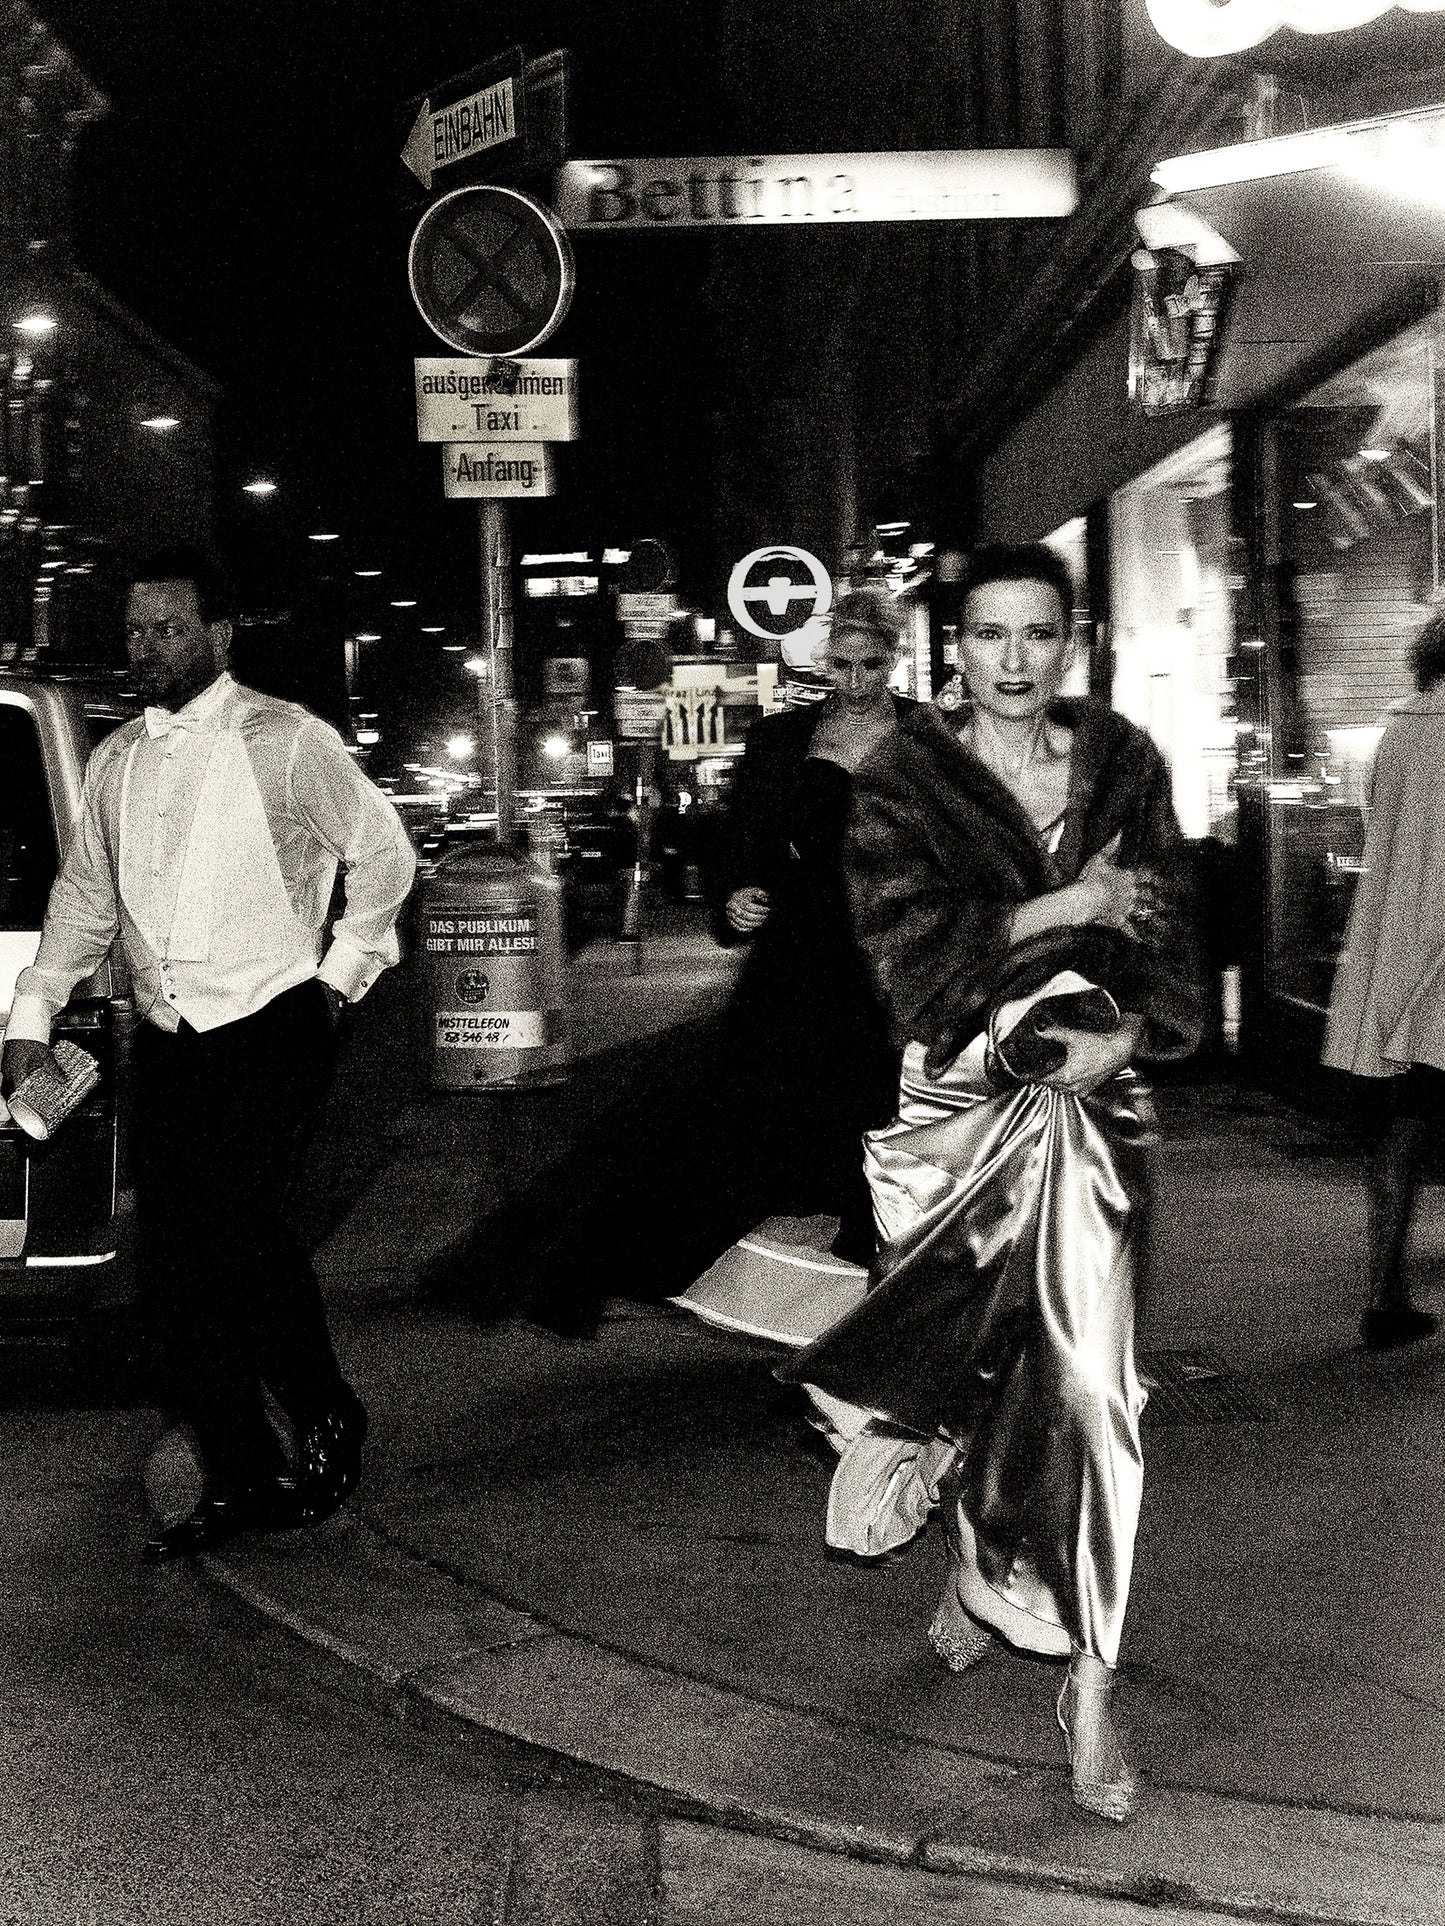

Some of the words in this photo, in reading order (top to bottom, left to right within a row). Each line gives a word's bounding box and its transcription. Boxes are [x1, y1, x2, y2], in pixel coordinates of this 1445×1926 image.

[434, 88, 508, 161] EINBAHN
[582, 158, 858, 222] Bettina
[471, 403, 519, 430] Taxi
[457, 453, 533, 488] Anfang
[429, 920, 455, 934] DAS
[458, 919, 530, 934] PUBLIKUM
[426, 938, 453, 951] GIBT
[457, 938, 484, 951] MIR
[488, 937, 535, 952] ALLES!
[438, 1018, 510, 1029] MISTTELEFON
[462, 1032, 482, 1042] 546
[485, 1032, 500, 1042] 48
